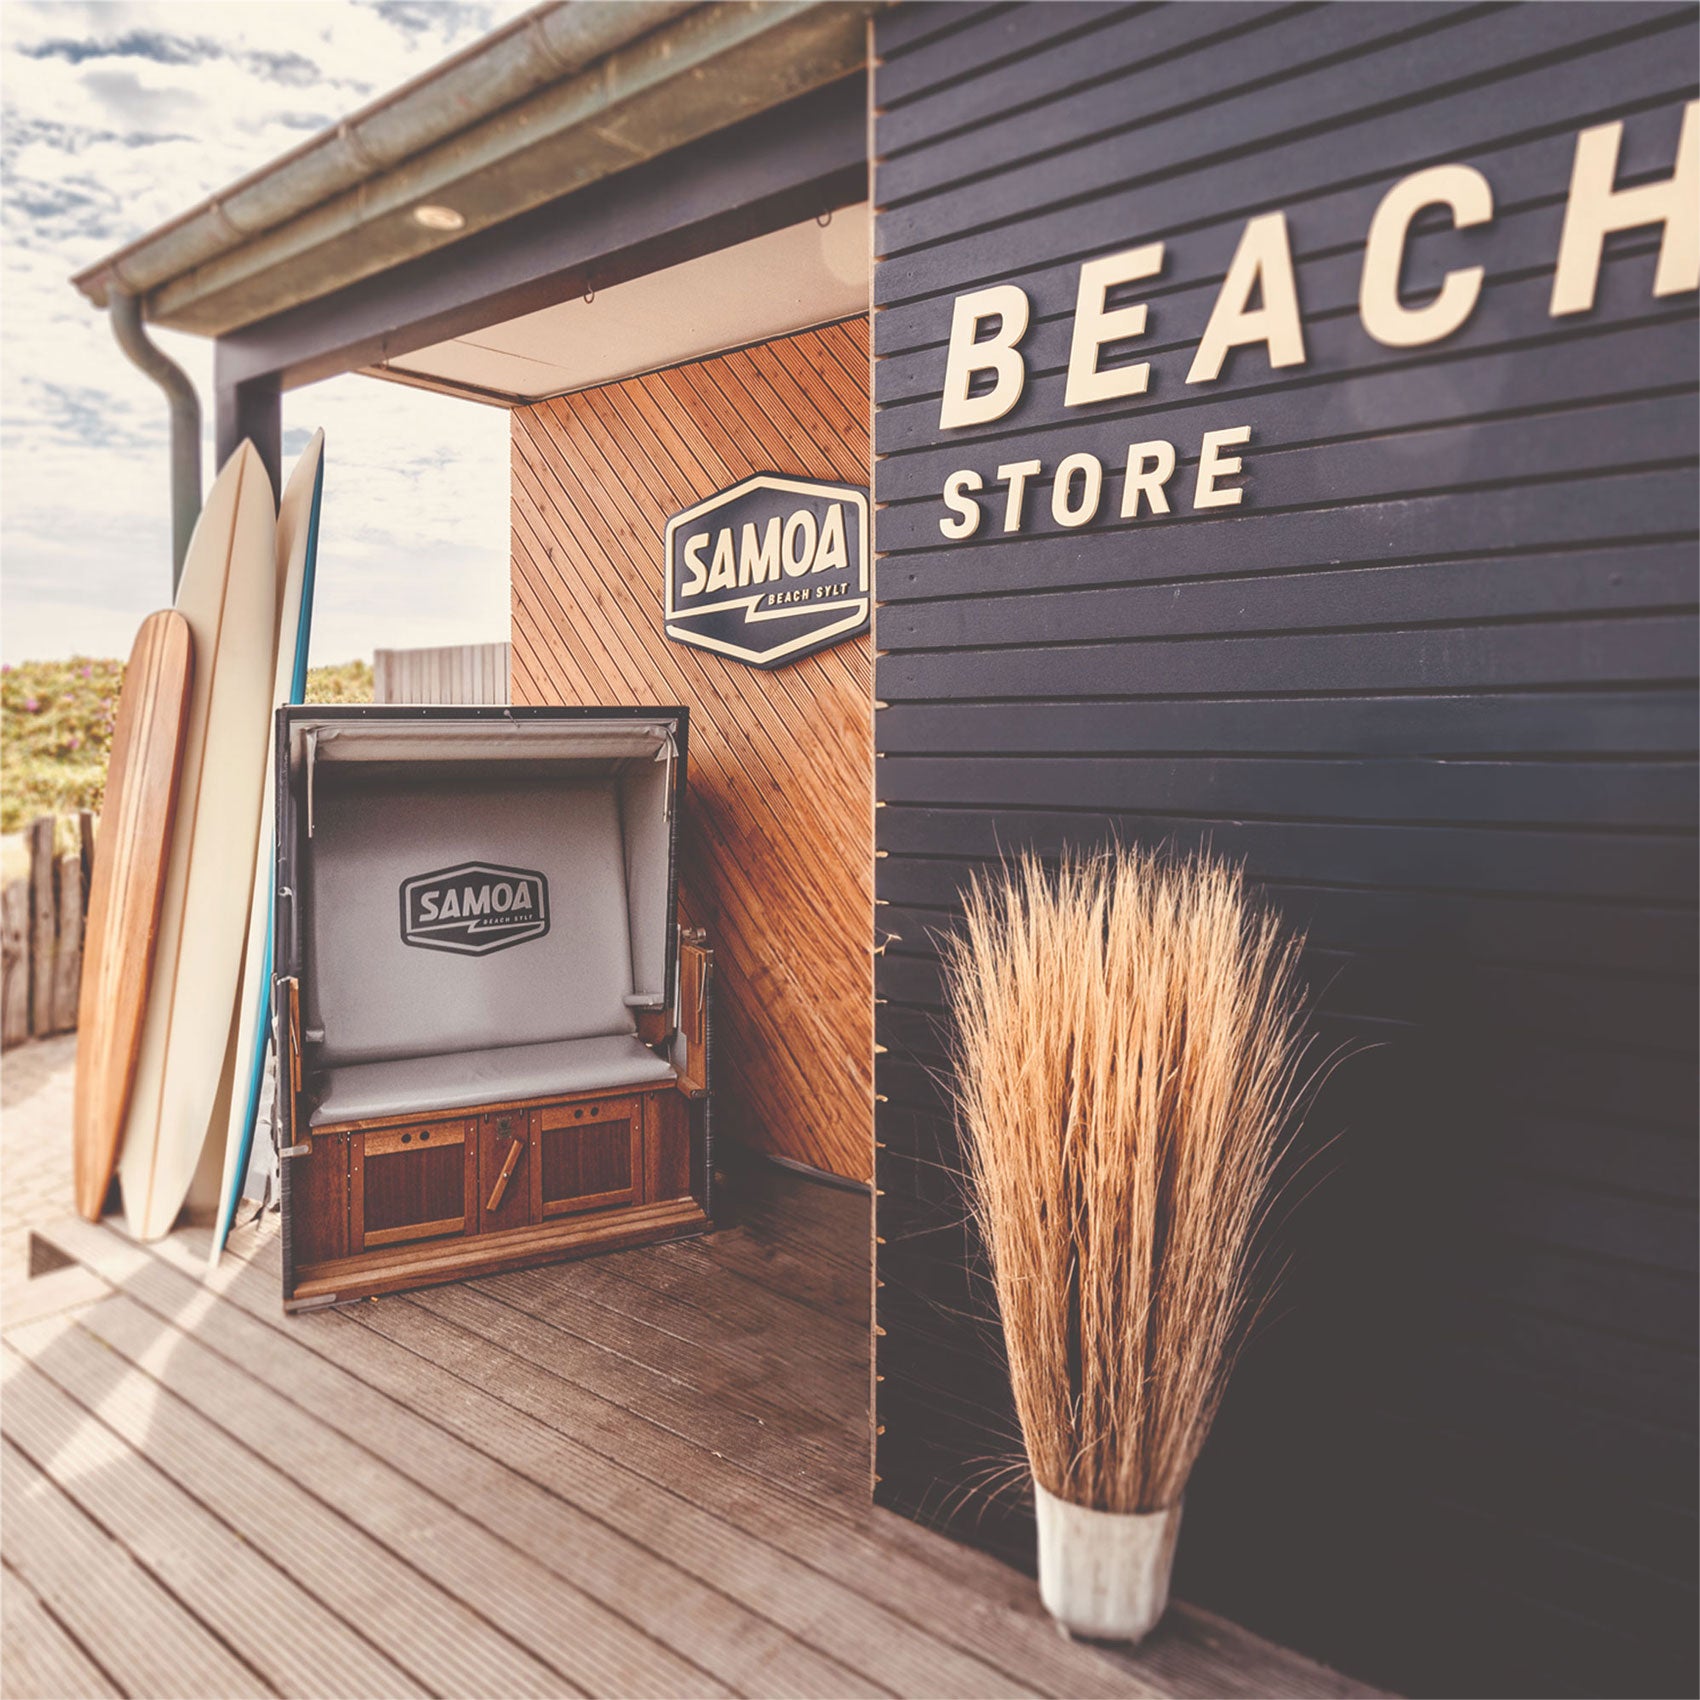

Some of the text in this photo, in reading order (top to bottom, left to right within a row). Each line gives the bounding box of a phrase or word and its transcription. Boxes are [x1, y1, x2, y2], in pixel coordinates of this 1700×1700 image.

[939, 100, 1700, 430] BEACH
[939, 425, 1252, 540] STORE
[681, 503, 848, 597] SAMOA
[768, 583, 848, 605] BEACH SYLT
[419, 881, 532, 922] SAMOA
